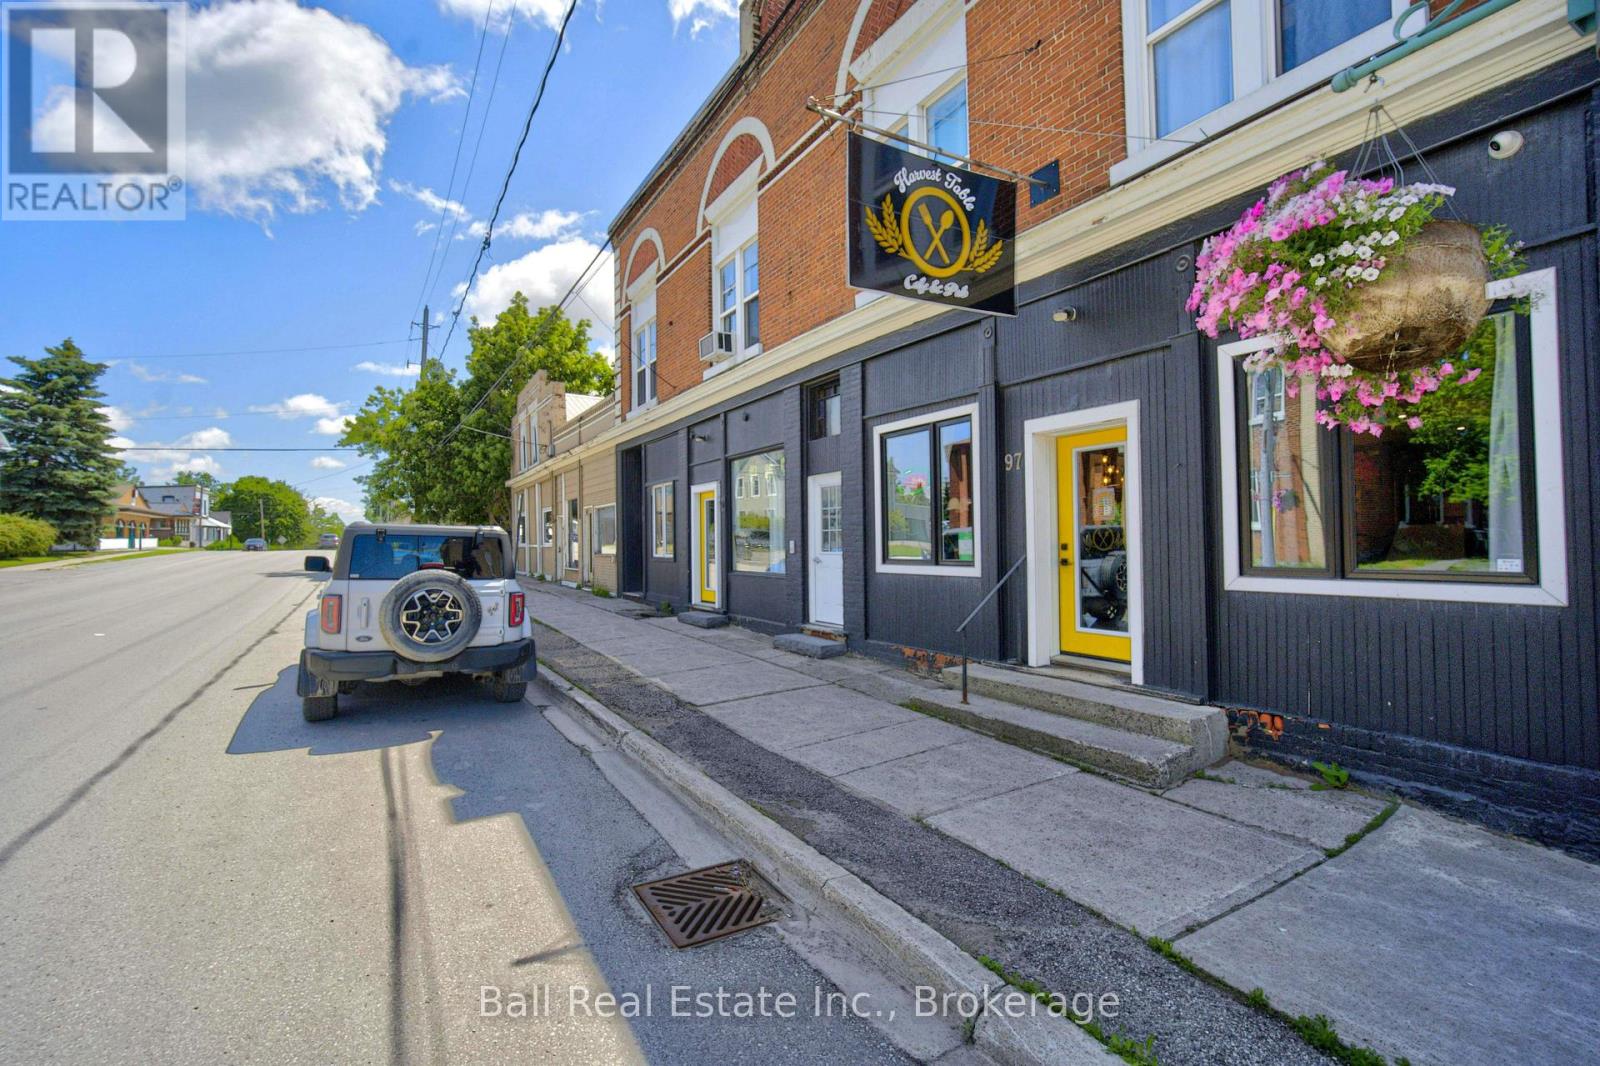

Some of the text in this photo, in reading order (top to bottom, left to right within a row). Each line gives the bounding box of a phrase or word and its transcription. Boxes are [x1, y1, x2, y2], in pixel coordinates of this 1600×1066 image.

[893, 166, 976, 212] Harvest Table
[1004, 452, 1022, 471] 97
